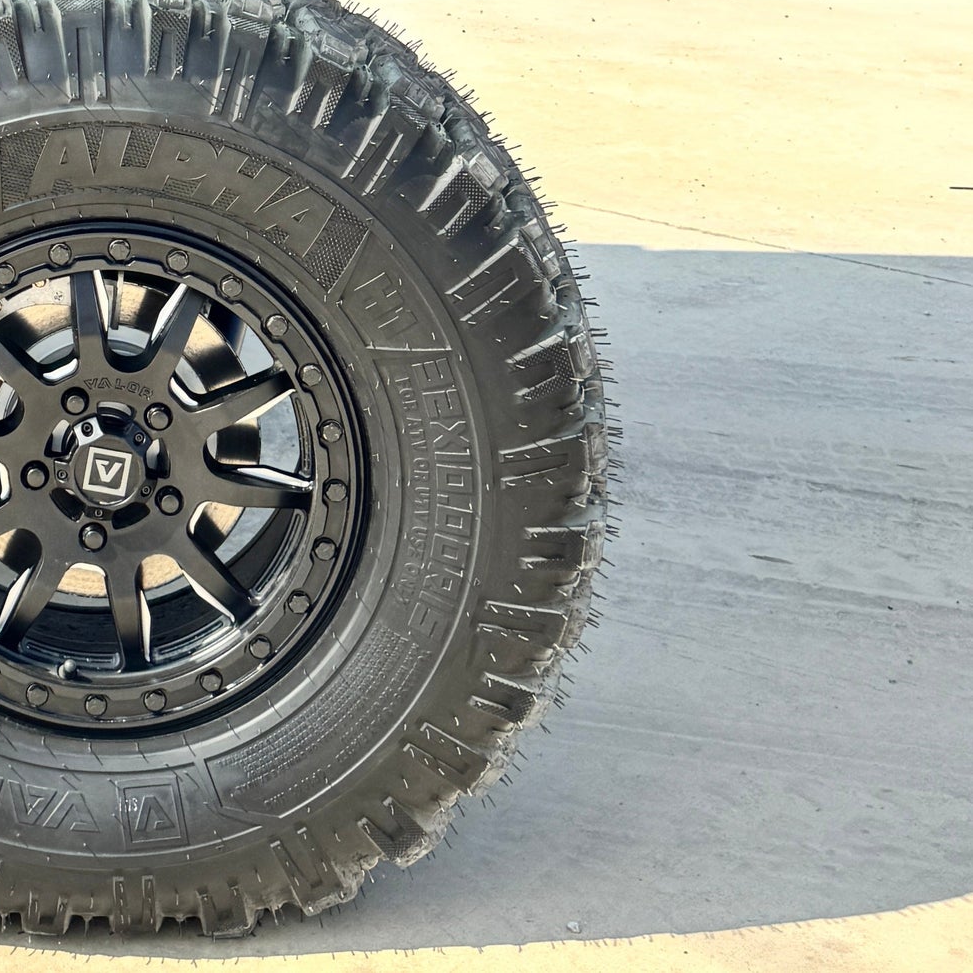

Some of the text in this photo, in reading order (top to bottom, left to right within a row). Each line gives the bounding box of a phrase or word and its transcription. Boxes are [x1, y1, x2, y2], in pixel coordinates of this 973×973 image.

[28, 126, 336, 258] ALPHA
[83, 377, 154, 401] VALOR
[394, 374, 419, 413] FOR
[406, 414, 427, 452] ATV
[412, 456, 429, 481] OR
[405, 525, 429, 561] USE
